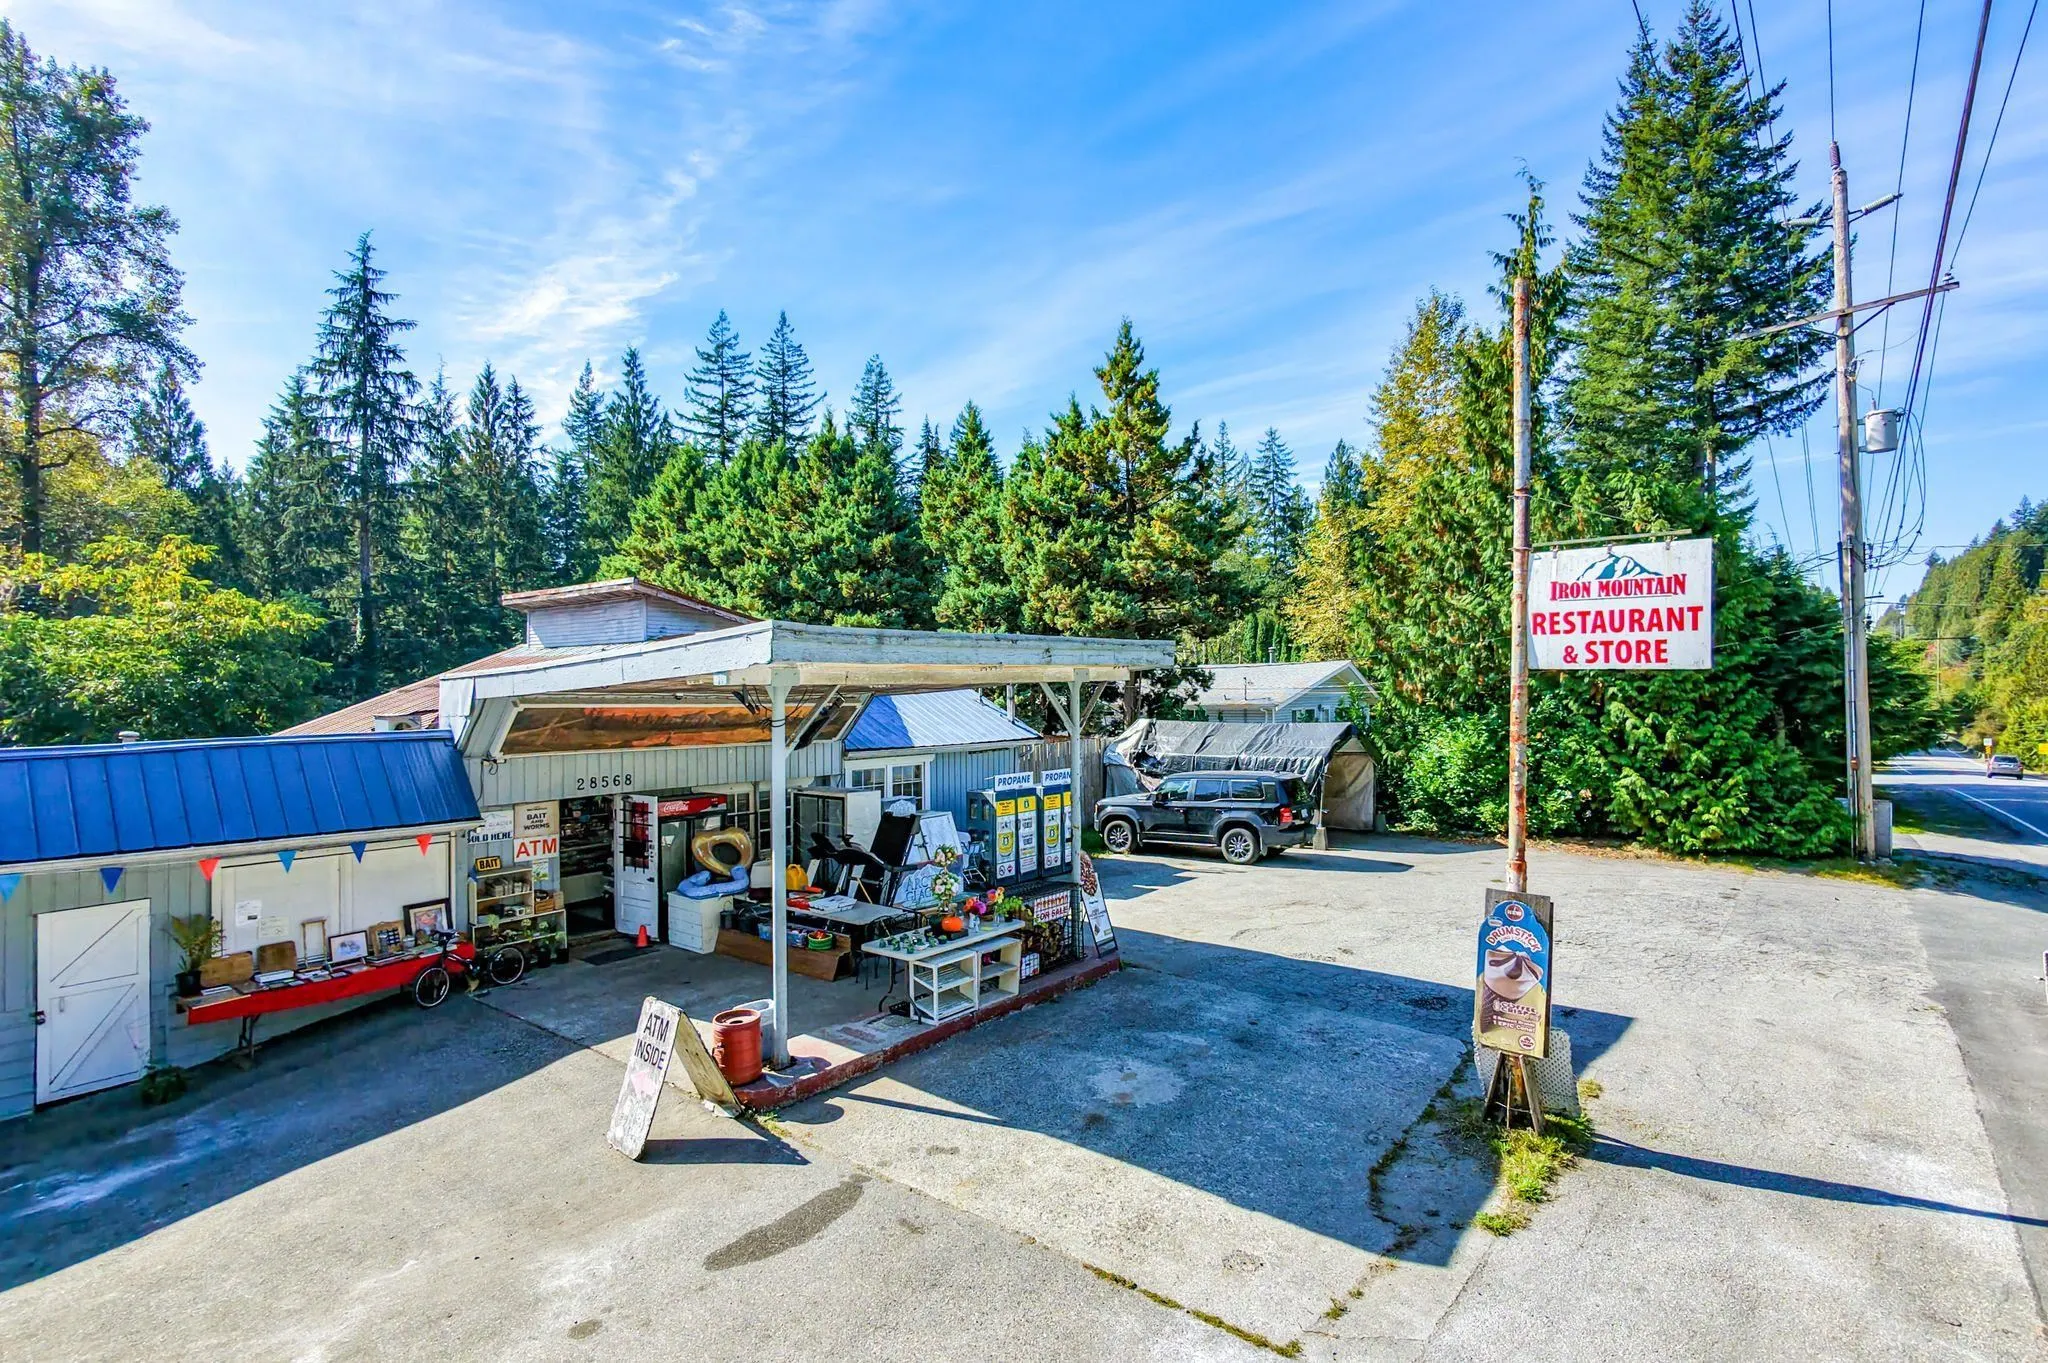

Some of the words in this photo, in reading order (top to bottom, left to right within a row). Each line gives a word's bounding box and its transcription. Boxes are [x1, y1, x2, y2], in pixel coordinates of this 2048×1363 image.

[1550, 580, 1591, 601] IRON
[1598, 573, 1687, 597] MOUNTAIN
[1532, 605, 1704, 635] RESTAURANT
[1562, 645, 1578, 665] &
[1585, 638, 1668, 664] STORE
[576, 773, 632, 790] 28568
[997, 774, 1031, 787] PROPANE
[1045, 770, 1071, 781] PROPAN
[526, 812, 547, 821] BAIT
[524, 822, 550, 831] WORMS
[490, 831, 513, 841] HERE
[516, 838, 557, 859] ATM
[479, 858, 498, 870] BAIT
[906, 874, 934, 891] ARC
[906, 886, 932, 901] GLAC
[643, 1012, 670, 1043] ATM
[634, 1038, 667, 1071] INSIDE
